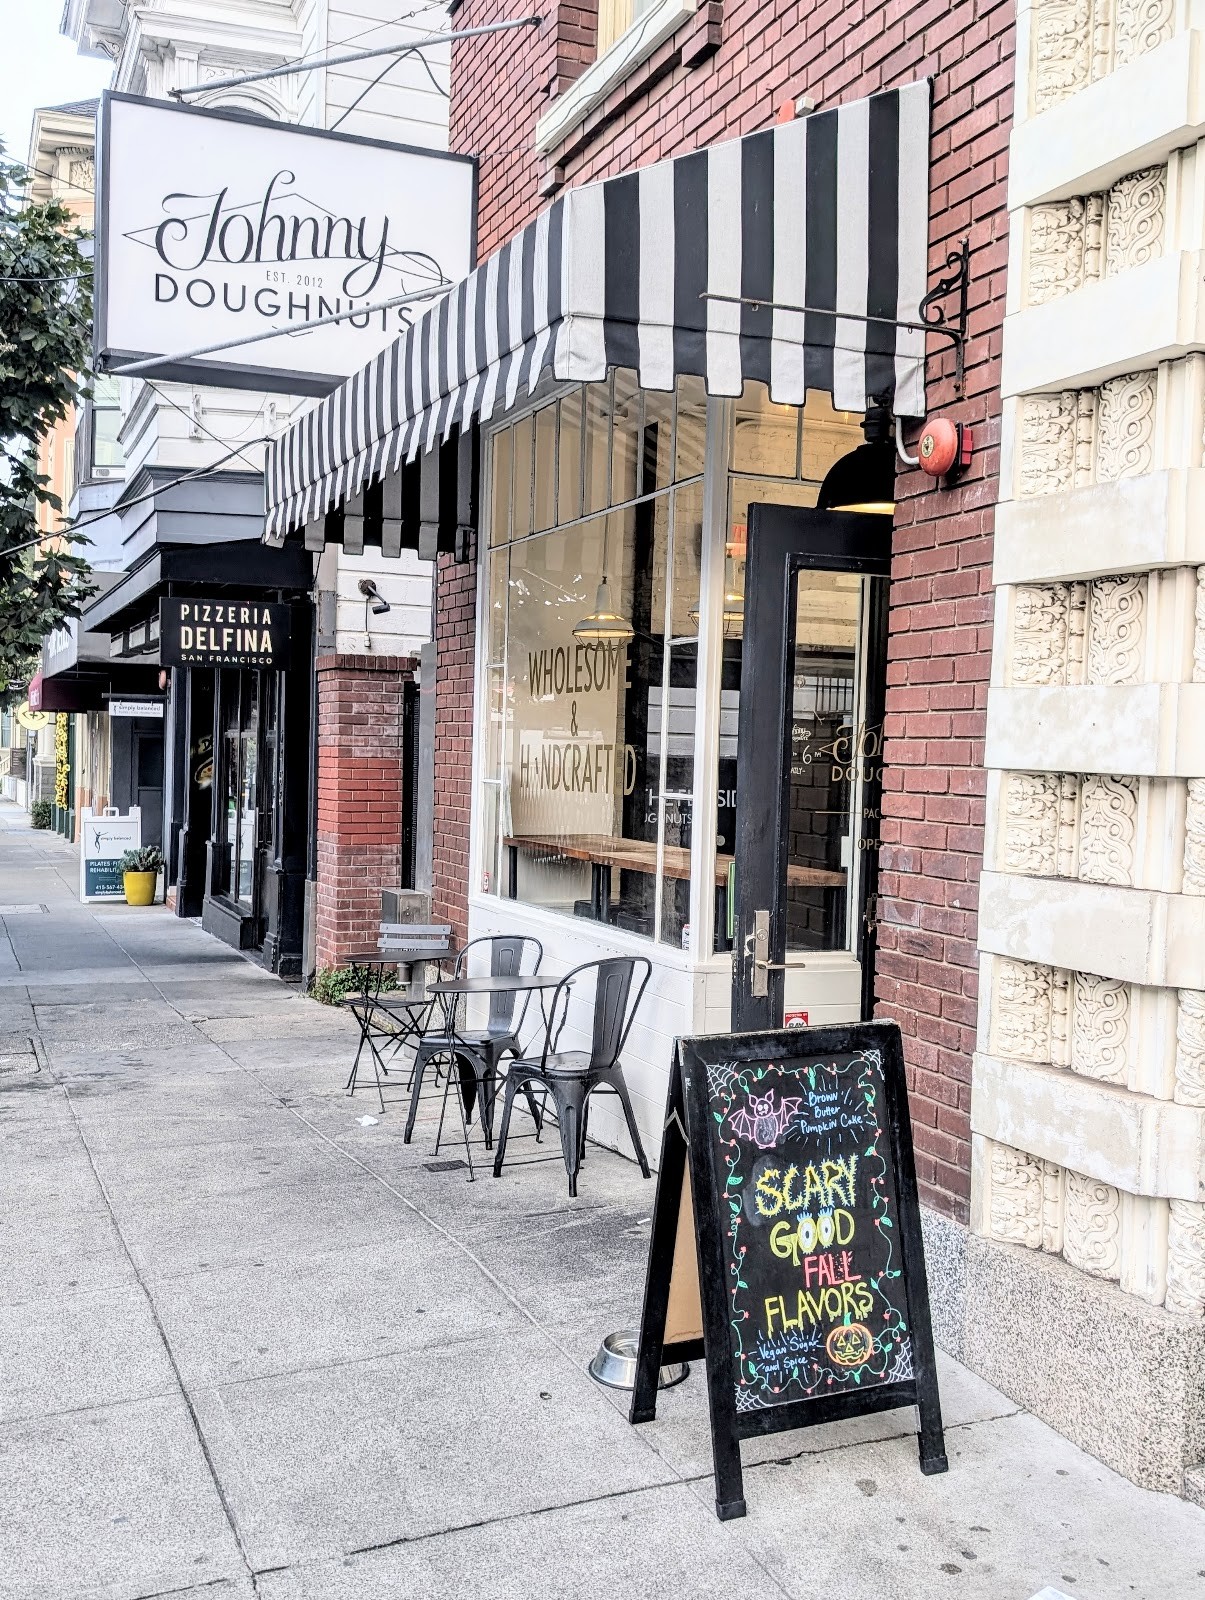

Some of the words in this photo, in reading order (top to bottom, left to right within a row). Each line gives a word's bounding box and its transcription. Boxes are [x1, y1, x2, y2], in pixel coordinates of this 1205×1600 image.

[155, 170, 390, 298] Johnny
[266, 270, 290, 284] EST.
[296, 274, 323, 288] 2012
[155, 273, 414, 333] DOUGHNUTS
[181, 604, 272, 625] PIZZERIA
[181, 626, 273, 653] DELFINA
[181, 653, 203, 661] SAN
[209, 655, 273, 664] FRANCISCO
[528, 637, 632, 696] WHOLESOME
[570, 700, 578, 736] &
[808, 1091, 838, 1107] Brown
[814, 1105, 841, 1118] Butter
[800, 1119, 837, 1135] Pumpkin
[840, 1113, 863, 1127] Cake
[755, 1153, 859, 1217] SCARY
[769, 1208, 855, 1267] GOOD
[804, 1250, 862, 1288] FALL
[764, 1282, 874, 1338] FLAVORS
[759, 1343, 787, 1360] Vegan
[789, 1336, 819, 1352] Sugar
[764, 1360, 780, 1372] and
[783, 1356, 808, 1370] Spice
